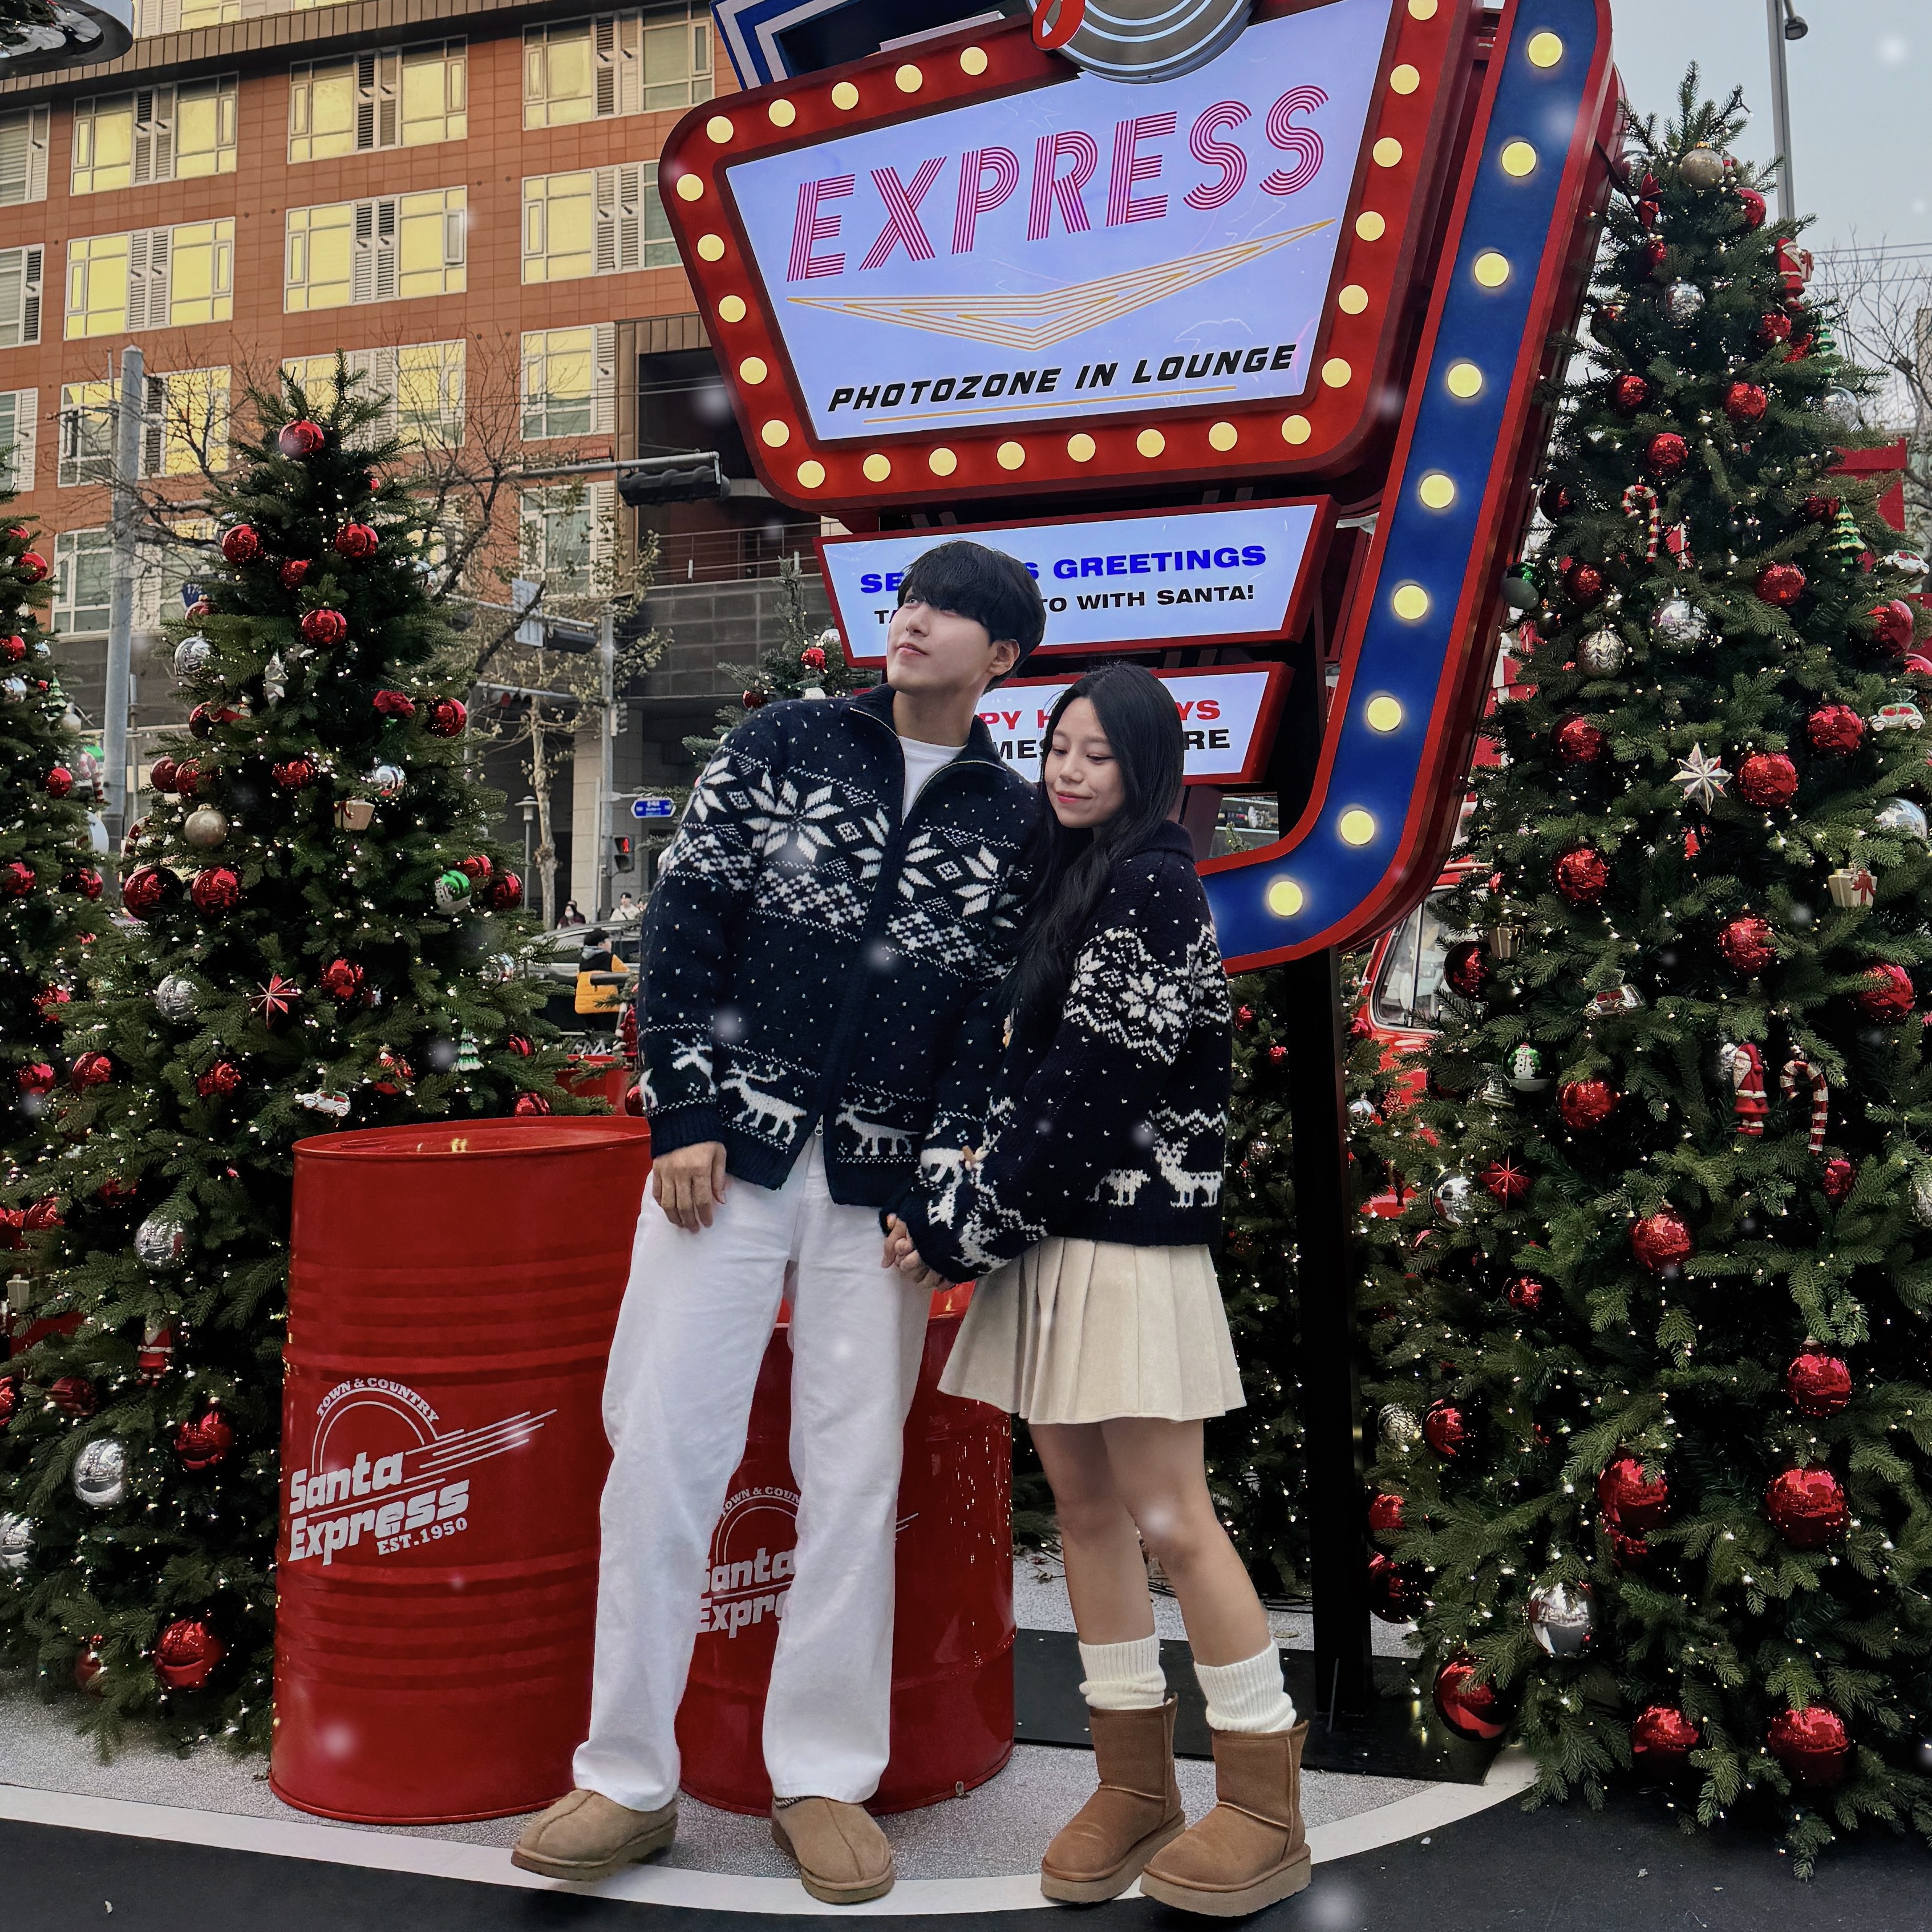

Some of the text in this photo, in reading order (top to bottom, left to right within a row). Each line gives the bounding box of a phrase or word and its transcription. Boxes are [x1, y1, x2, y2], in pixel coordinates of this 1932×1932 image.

[787, 85, 1328, 282] EXPRESS
[828, 345, 1296, 411] PHOTOZONE IN LOUNGE
[1054, 546, 1266, 578] GREETINGS
[1077, 592, 1144, 609] WITH
[1157, 585, 1253, 605] SANTA!
[317, 1378, 439, 1422] TOWN & COUNTRY
[289, 1452, 404, 1514] Santa
[753, 1487, 762, 1496] &
[765, 1487, 800, 1504] COUN
[288, 1480, 469, 1566] Express
[376, 1517, 467, 1556] EST.1950
[697, 1590, 788, 1639] Expr
